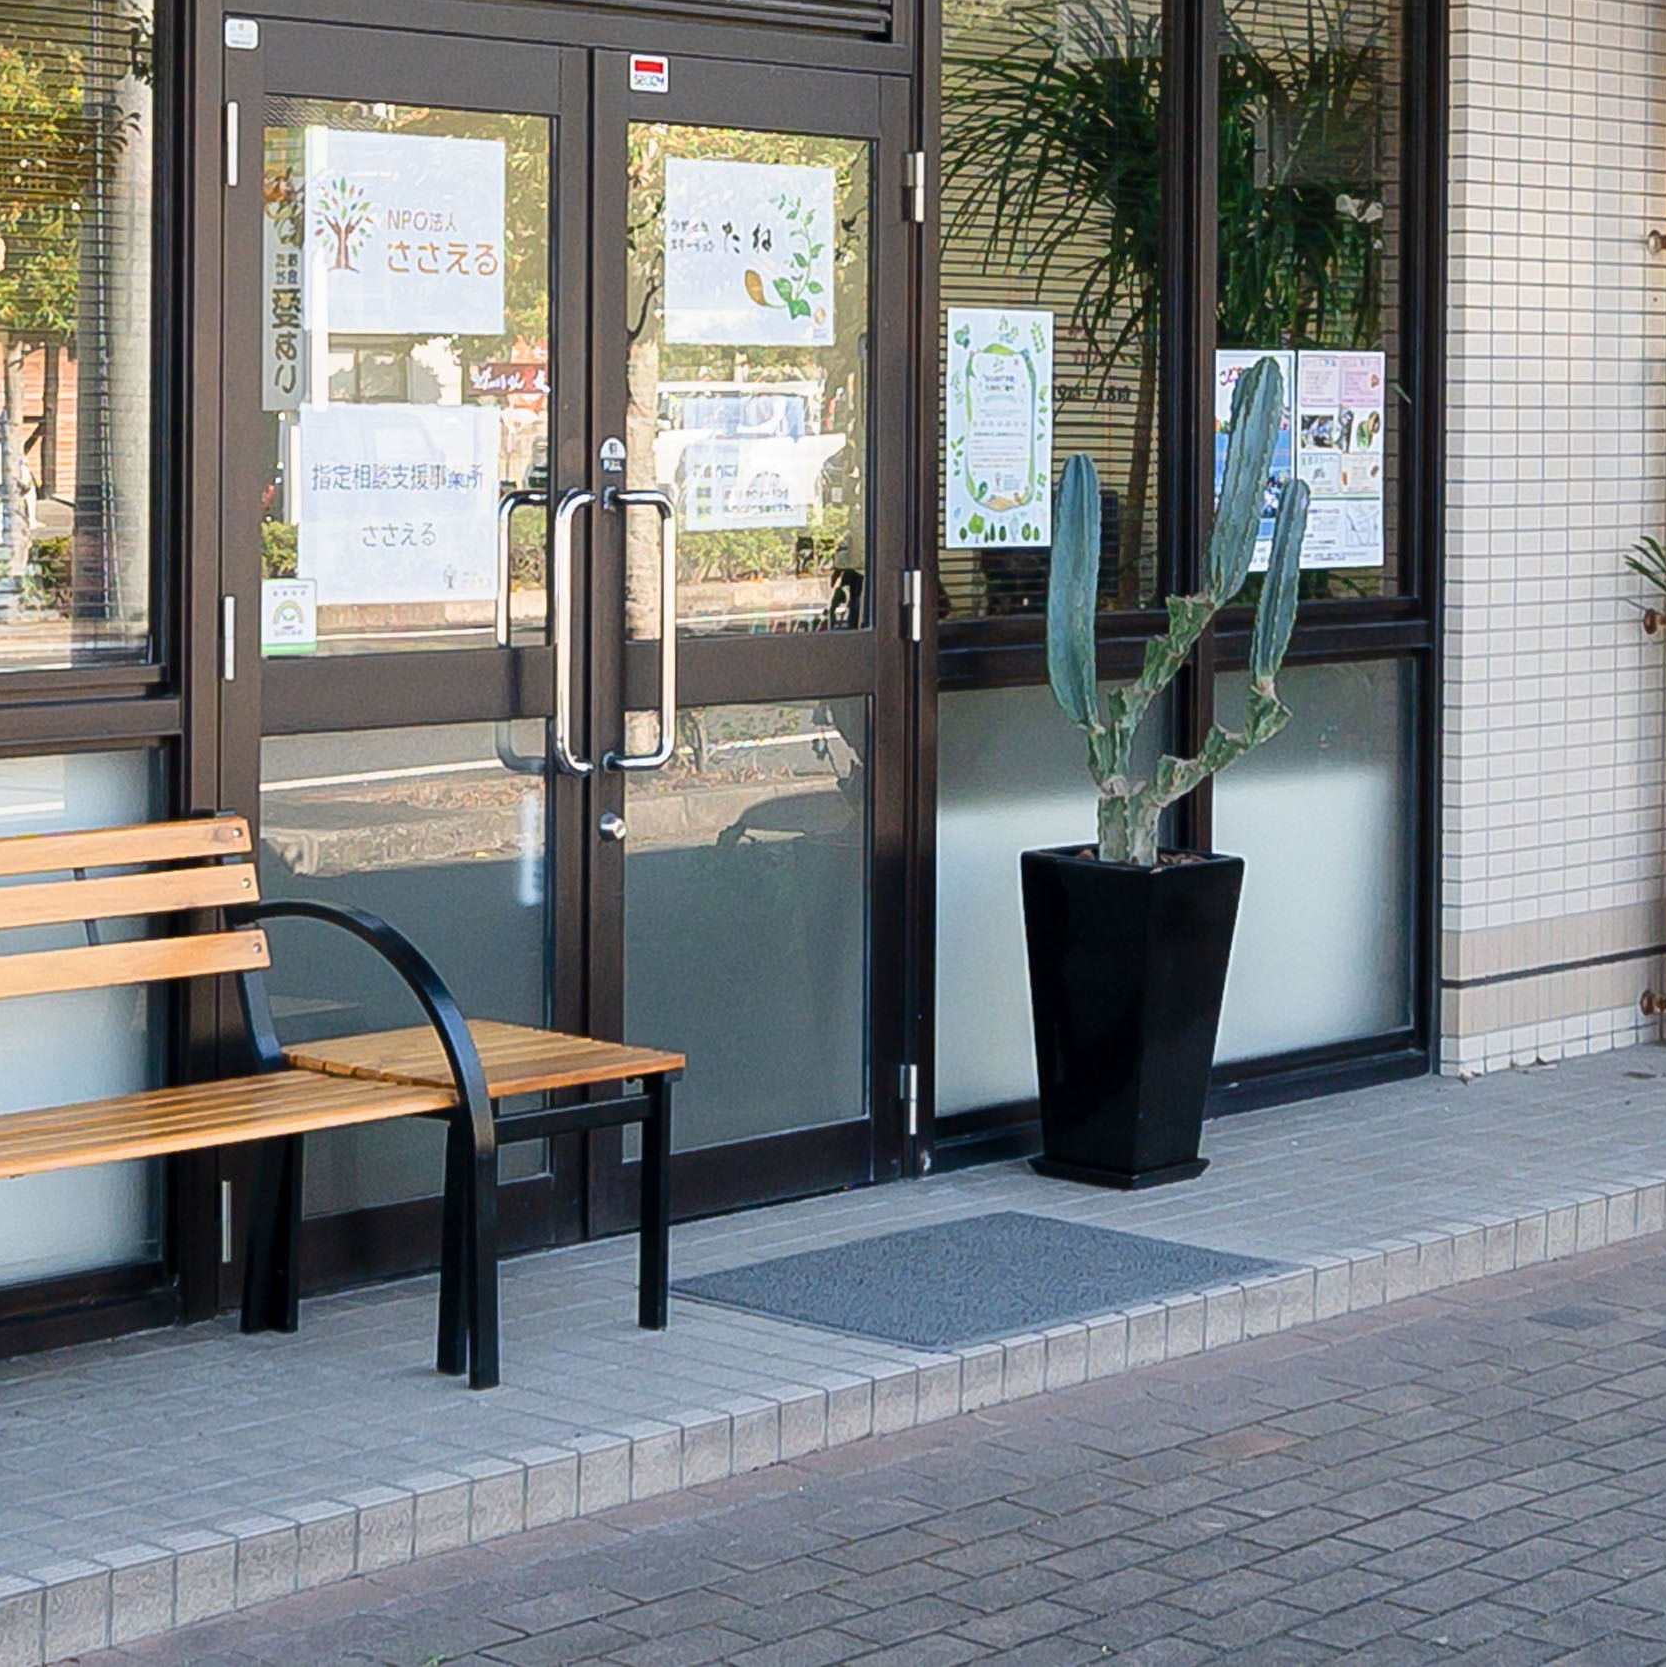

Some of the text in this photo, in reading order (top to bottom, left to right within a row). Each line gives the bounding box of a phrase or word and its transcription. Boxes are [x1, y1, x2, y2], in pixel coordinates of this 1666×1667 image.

[387, 209, 458, 233] NPO法人
[722, 220, 772, 254] たね
[387, 240, 499, 277] ささえる
[362, 522, 437, 547] ささえる
